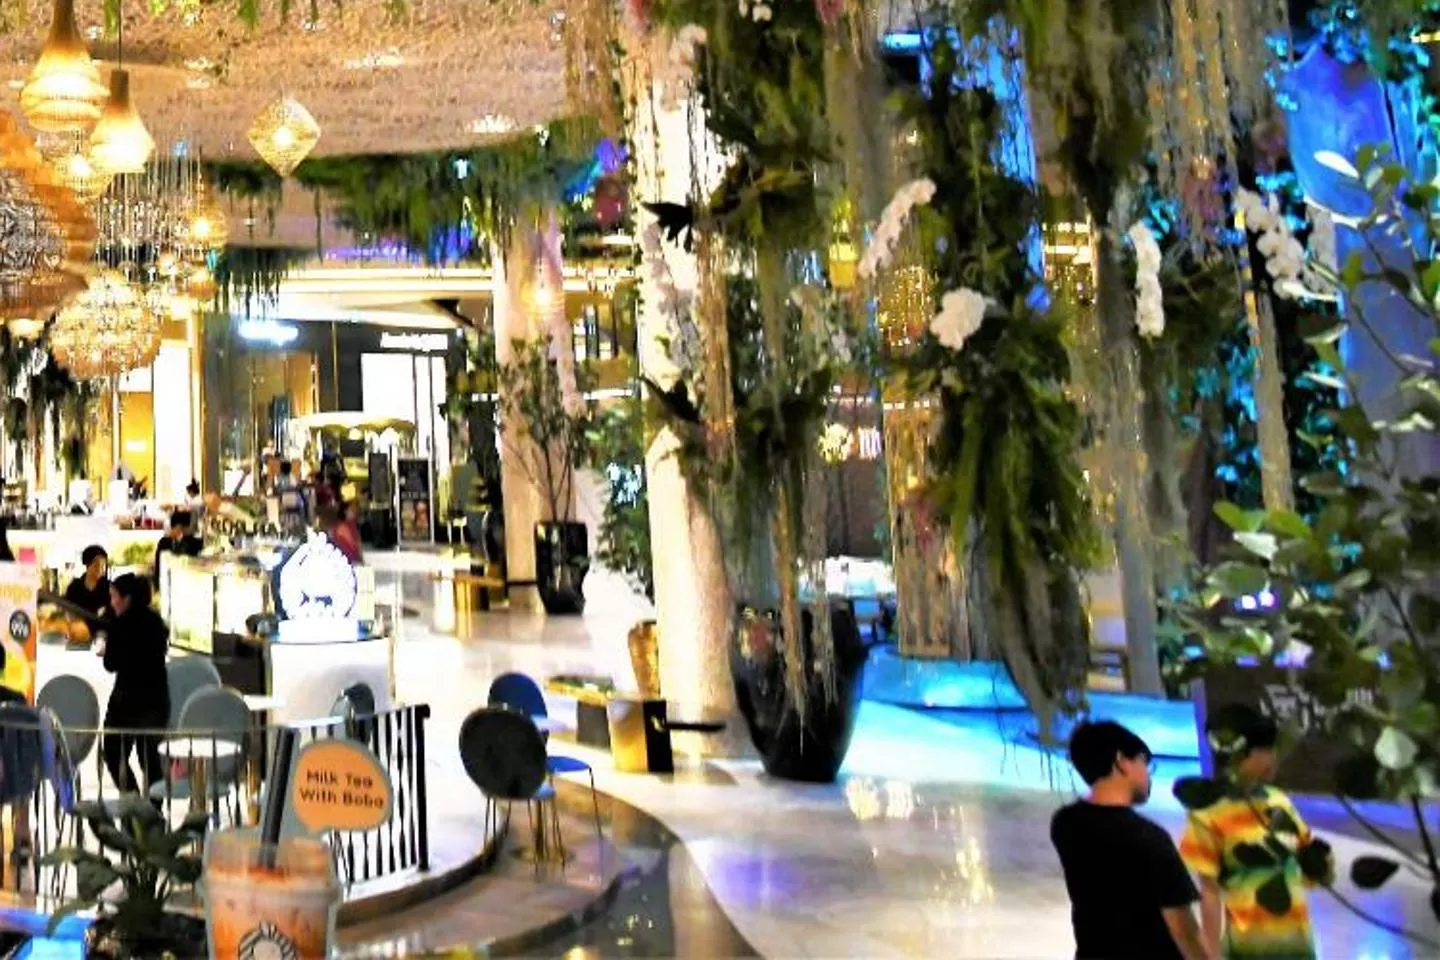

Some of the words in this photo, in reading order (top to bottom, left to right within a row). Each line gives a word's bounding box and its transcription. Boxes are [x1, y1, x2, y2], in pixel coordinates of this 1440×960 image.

[306, 768, 338, 785] Milk
[345, 771, 373, 788] Tea
[300, 786, 337, 804] With
[343, 790, 384, 809] Boba
